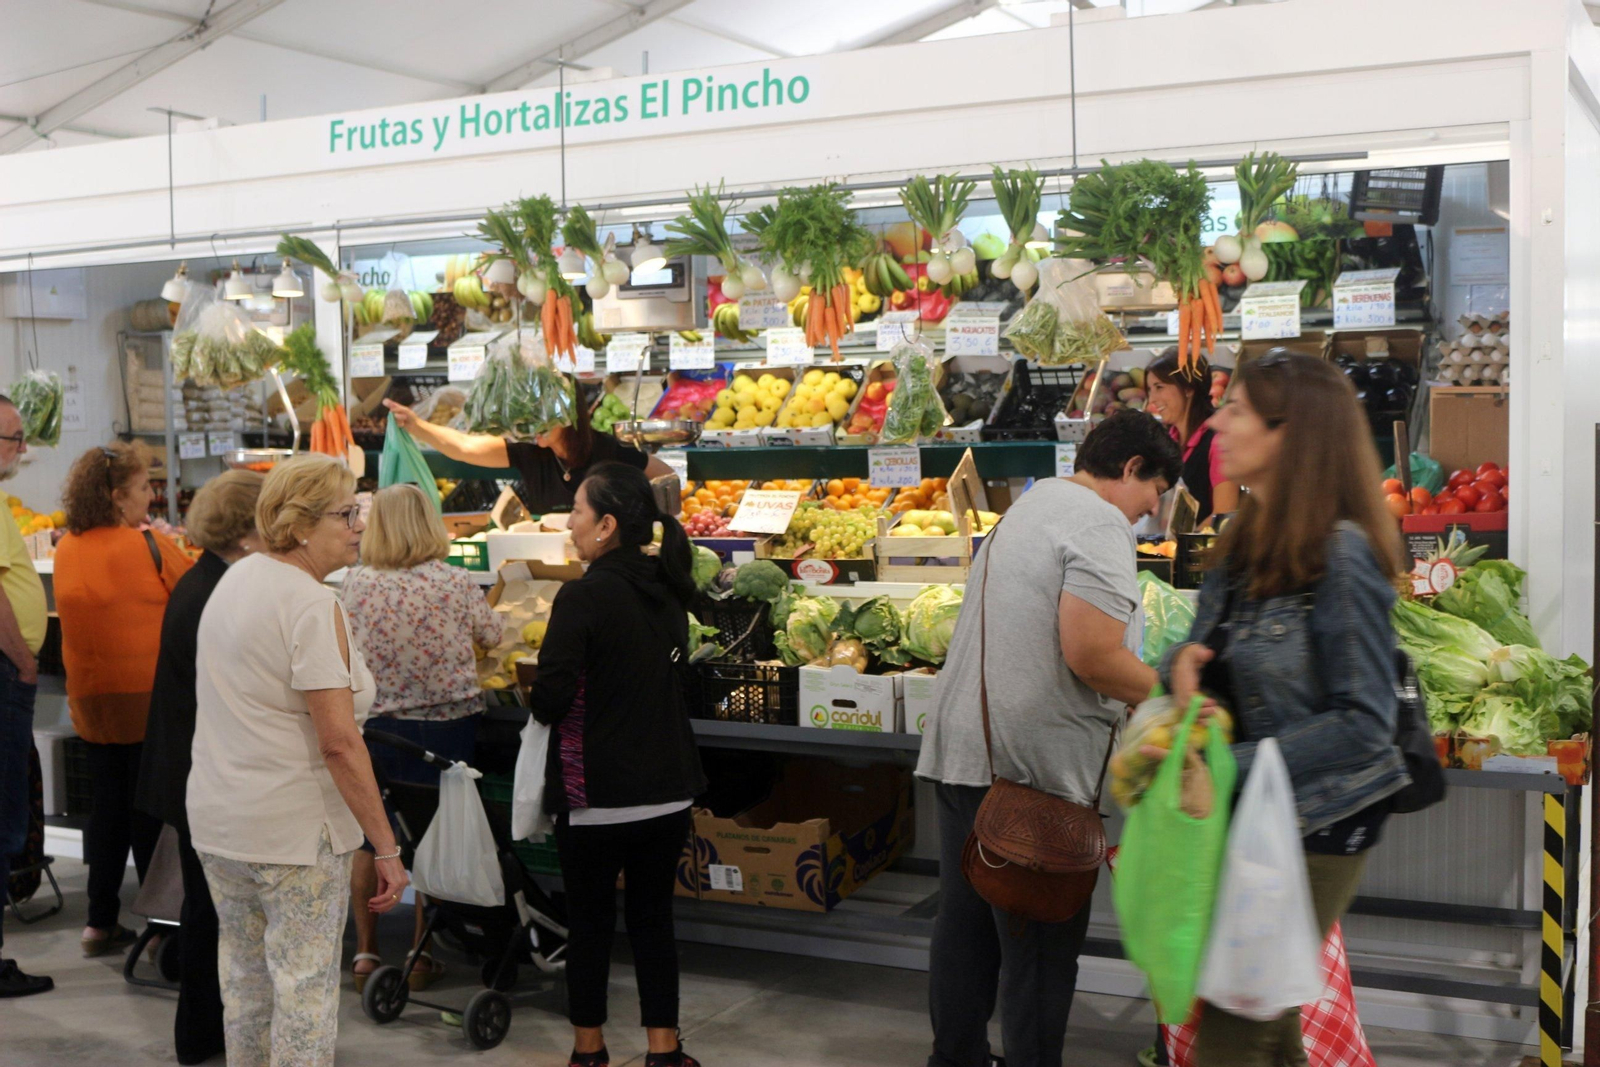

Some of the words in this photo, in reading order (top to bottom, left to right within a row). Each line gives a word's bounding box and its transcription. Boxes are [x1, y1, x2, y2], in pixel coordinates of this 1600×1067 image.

[330, 118, 423, 153] Frutas
[432, 114, 451, 152] y
[460, 92, 629, 138] Hortalizas
[640, 79, 671, 120] El
[682, 67, 811, 115] Pincho
[962, 327, 995, 335] AGUACATES
[885, 457, 917, 466] CEBOLLAS
[757, 501, 793, 511] UVAS
[832, 709, 882, 726] caridul
[762, 835, 797, 845] CANARIAS
